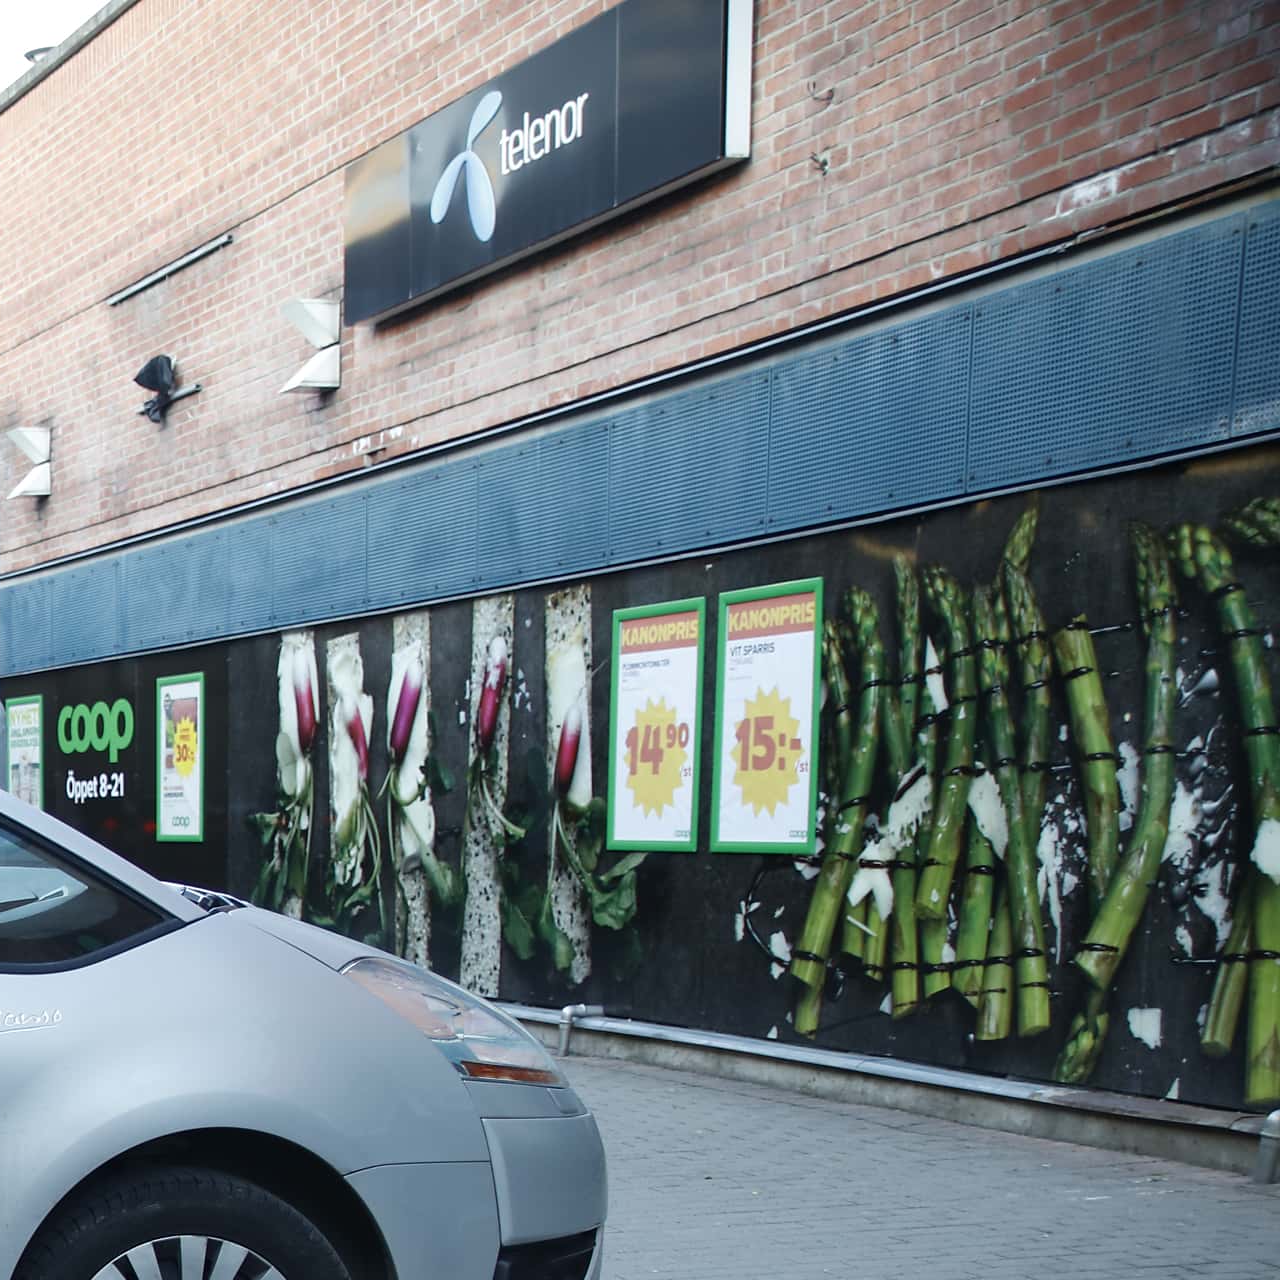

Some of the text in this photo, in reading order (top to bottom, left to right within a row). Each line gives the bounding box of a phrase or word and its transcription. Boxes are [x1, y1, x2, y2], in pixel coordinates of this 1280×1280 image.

[499, 92, 589, 176] telenor
[621, 619, 698, 647] KANONPRIS
[729, 600, 815, 632] KANONPRIS
[57, 698, 134, 763] coop
[735, 716, 801, 771] 15:-
[66, 771, 125, 804] Öppet 8-21
